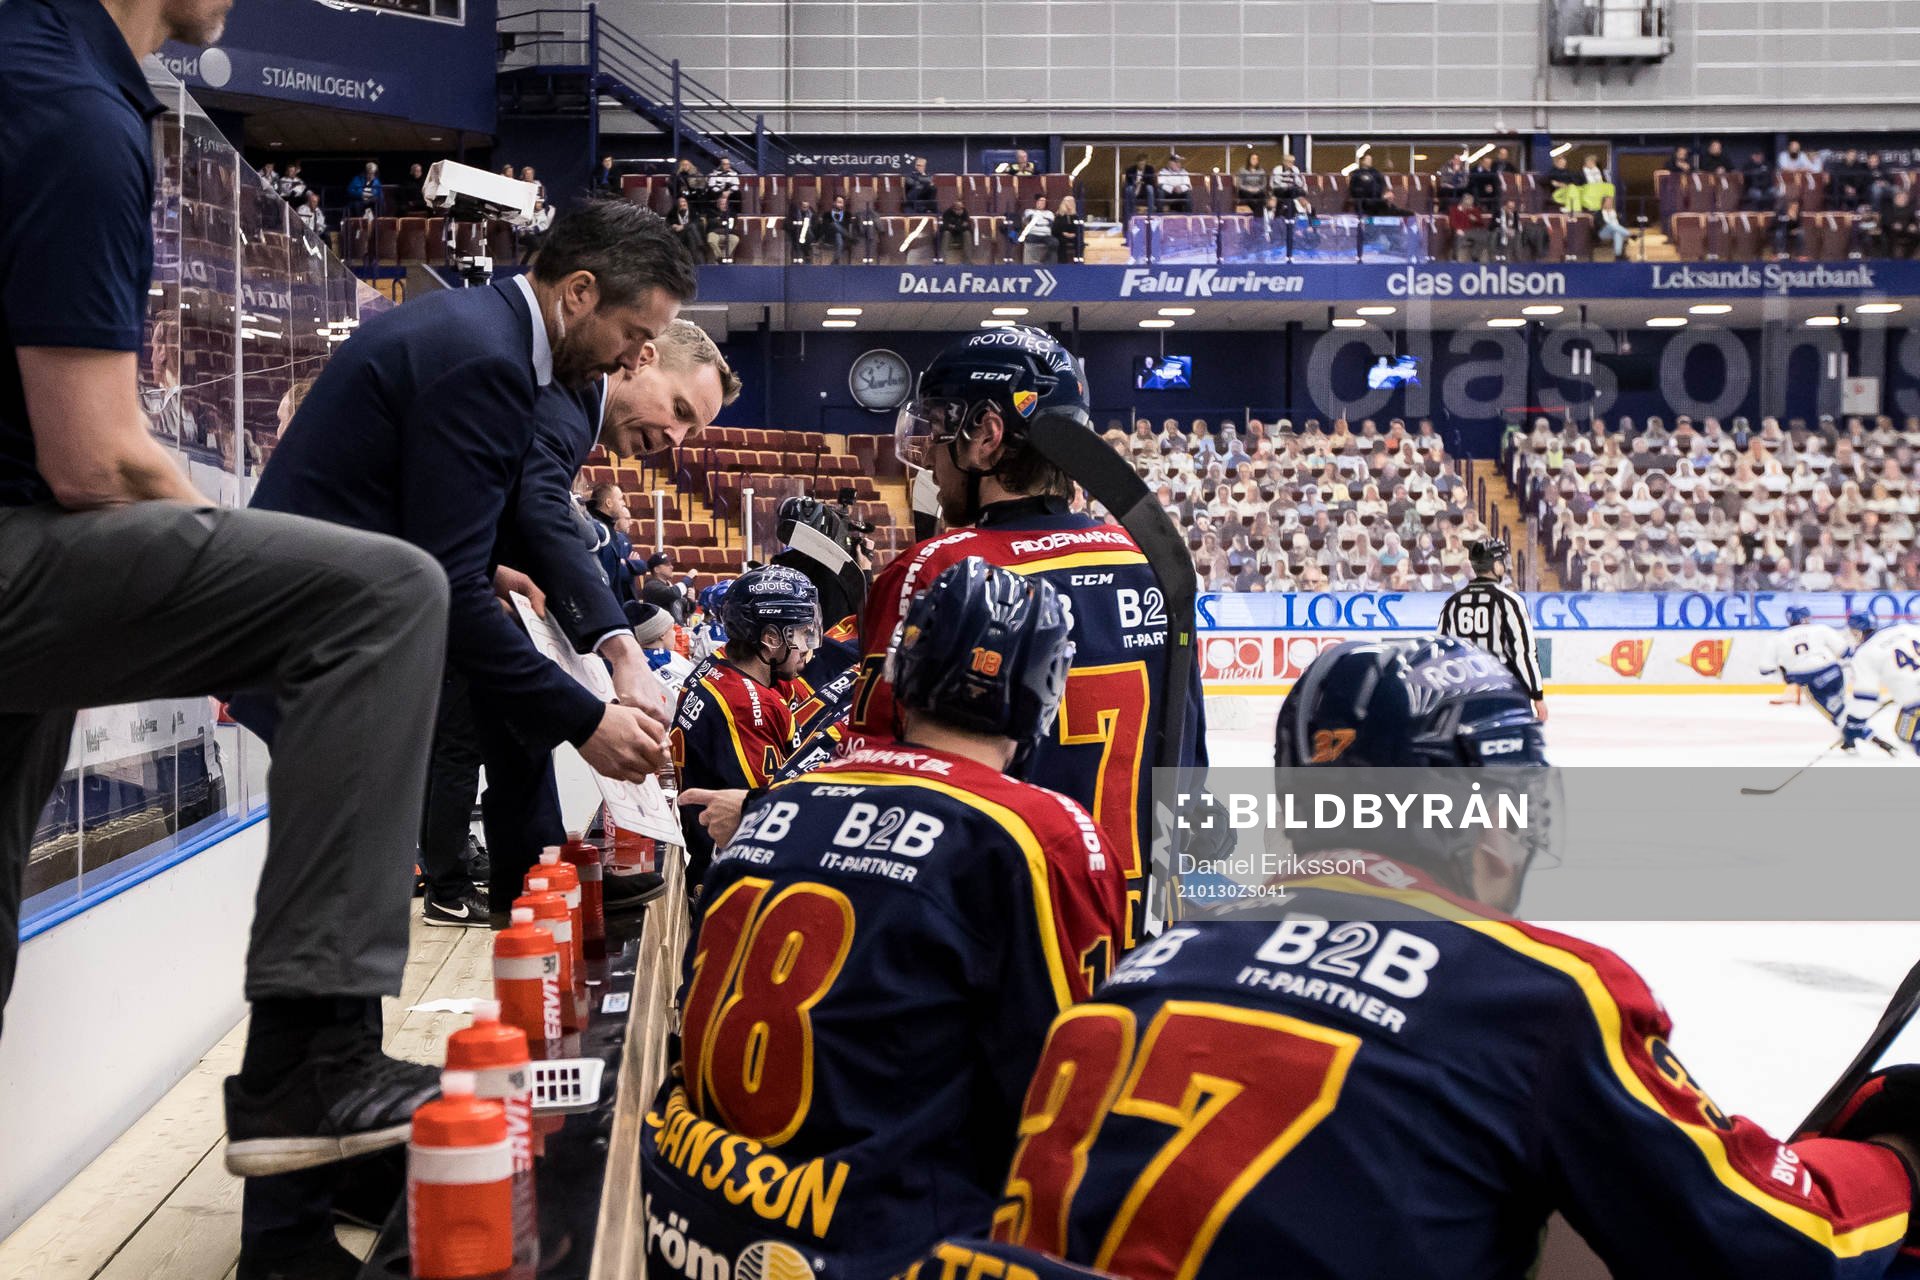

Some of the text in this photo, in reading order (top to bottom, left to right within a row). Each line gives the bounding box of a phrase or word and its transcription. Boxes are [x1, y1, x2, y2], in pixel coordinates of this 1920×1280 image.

[262, 66, 366, 100] STJÄRNLOGEN
[1387, 266, 1567, 296] clas ohlson
[1652, 265, 1876, 294] Leksands Sparbank
[970, 370, 1014, 382] CCM
[748, 582, 794, 593] ROTOTEC
[1071, 573, 1114, 587] CCM
[1116, 586, 1168, 629] B2
[1457, 605, 1489, 635] 60
[971, 646, 1003, 678] 18
[1481, 738, 1524, 755] CCM
[811, 785, 867, 798] CCM
[832, 802, 945, 858] B2B
[819, 851, 918, 883] IT-PARTNER
[1256, 912, 1440, 999] B2B
[680, 876, 857, 1148] 18
[1238, 964, 1407, 1034] IT-PARTNER
[990, 1000, 1363, 1280] 37
